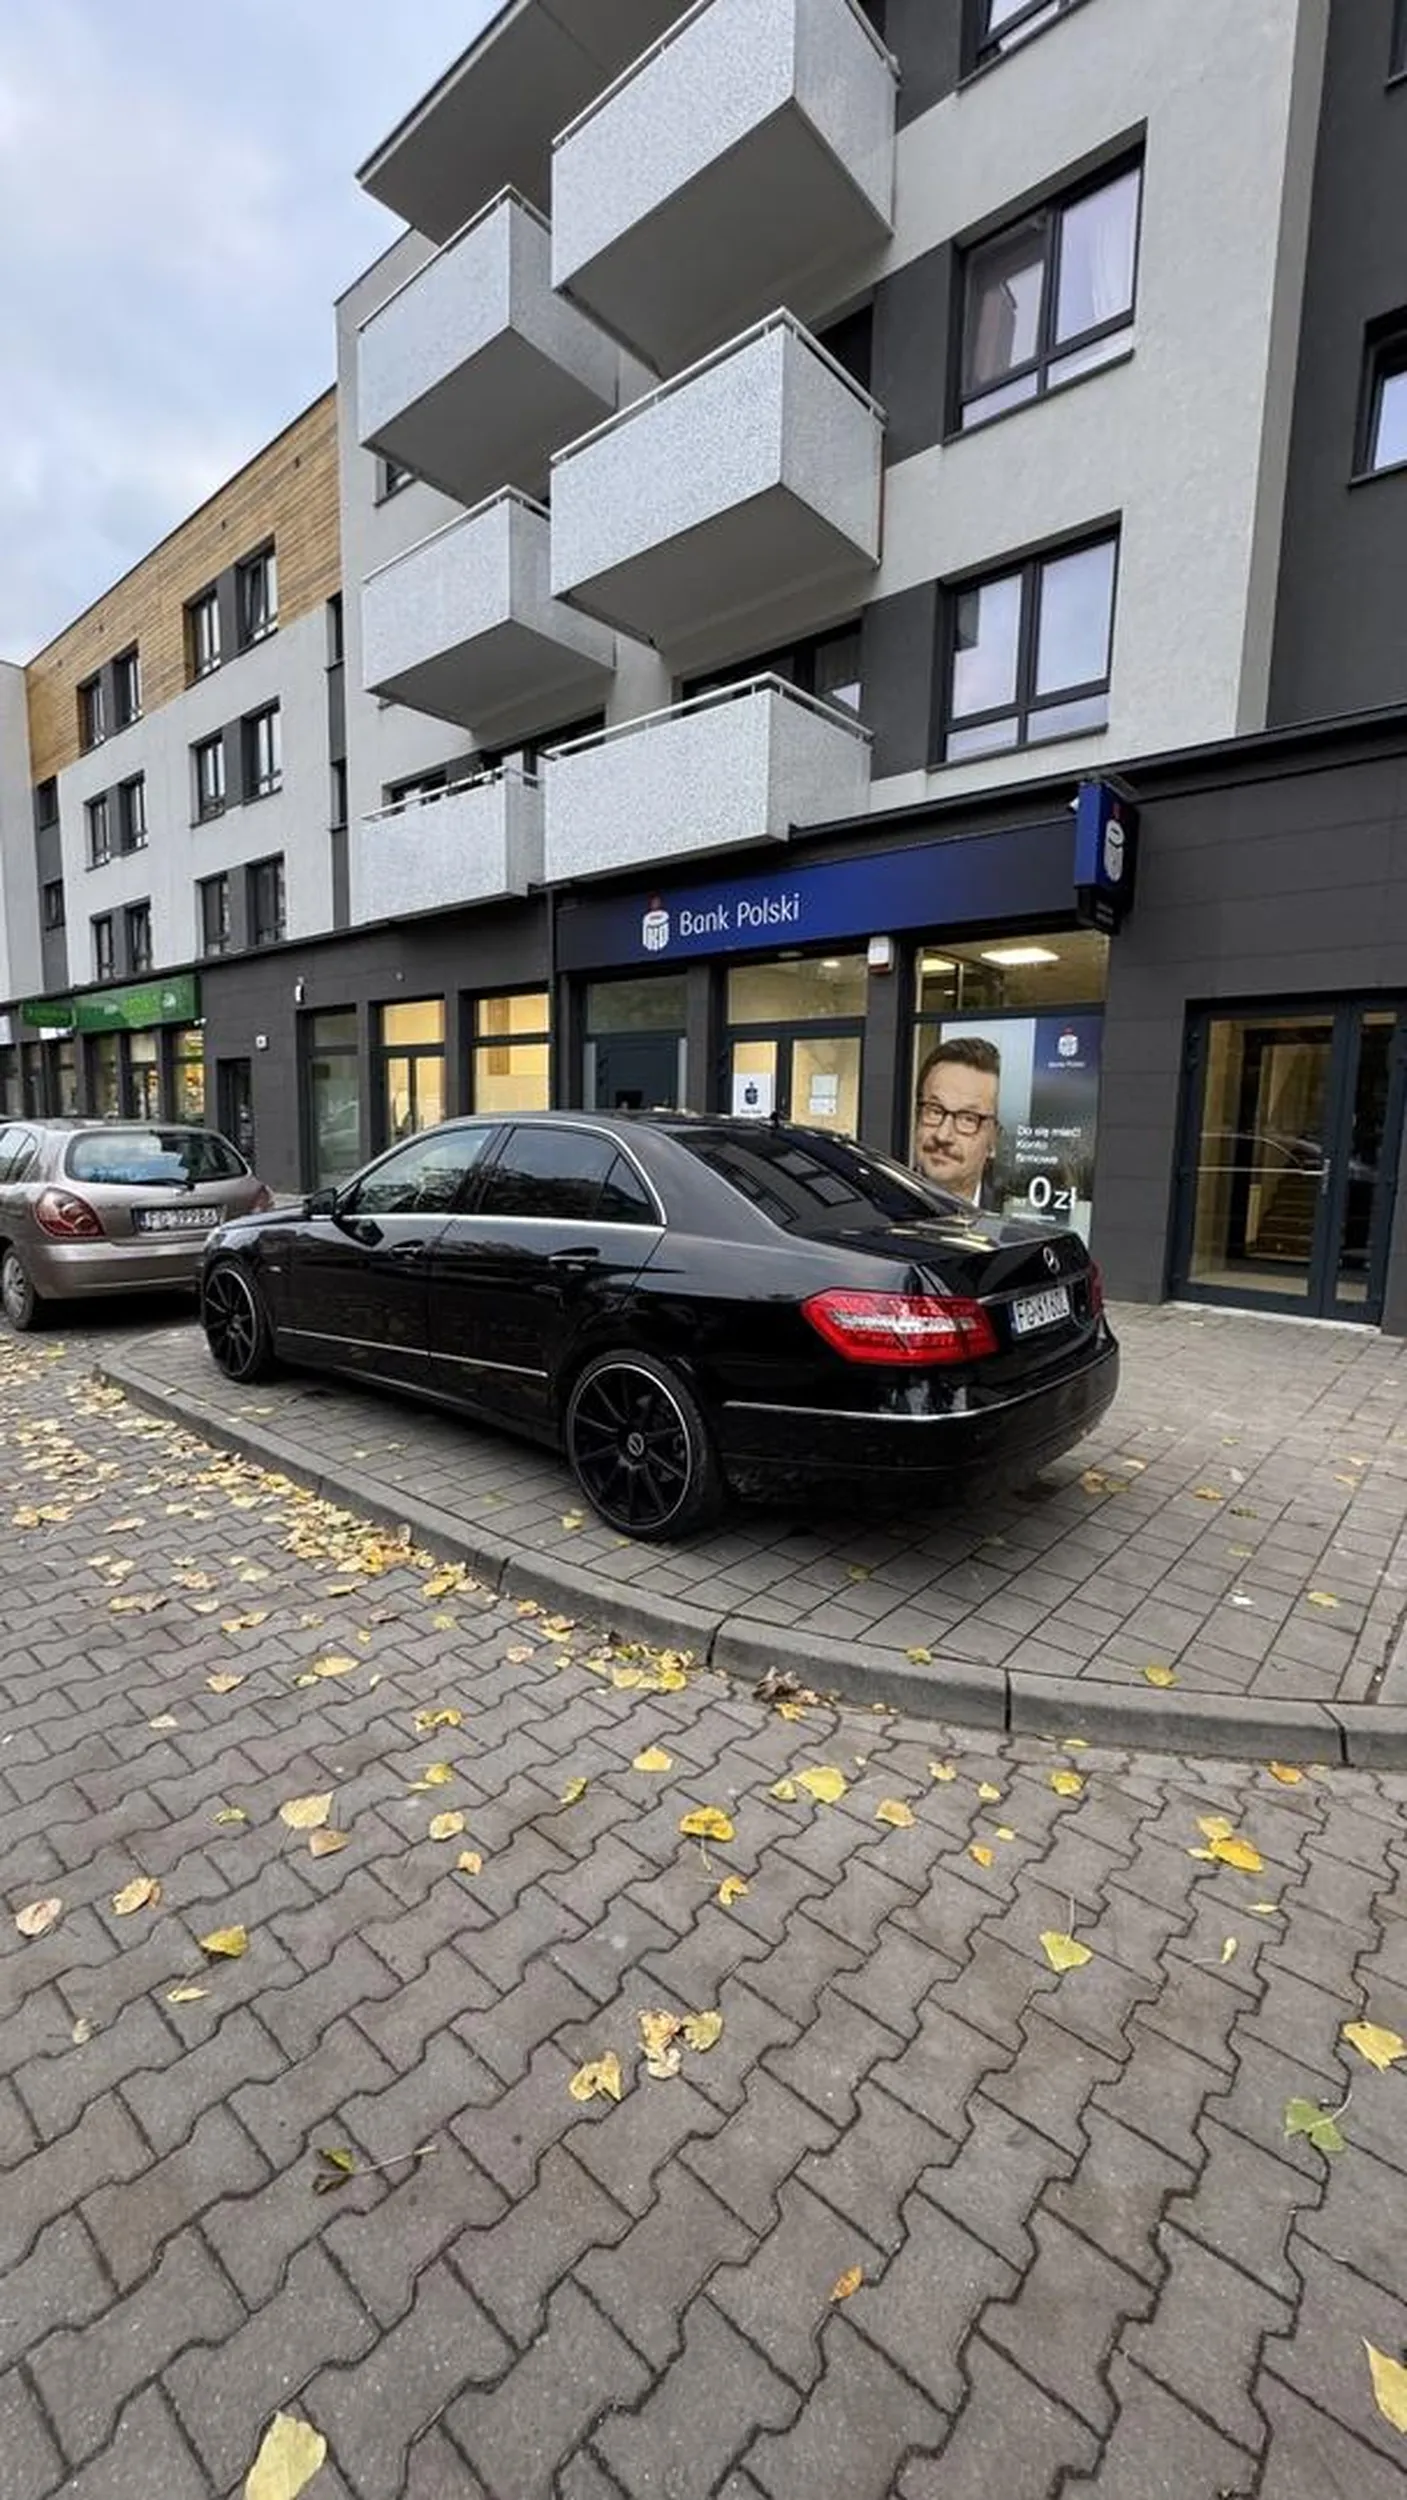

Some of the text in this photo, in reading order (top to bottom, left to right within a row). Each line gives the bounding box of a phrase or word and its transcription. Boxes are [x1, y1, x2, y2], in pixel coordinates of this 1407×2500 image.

[680, 893, 800, 936] Bank Polski
[1016, 1140, 1049, 1150] Konto
[1028, 1176, 1051, 1208] 0
